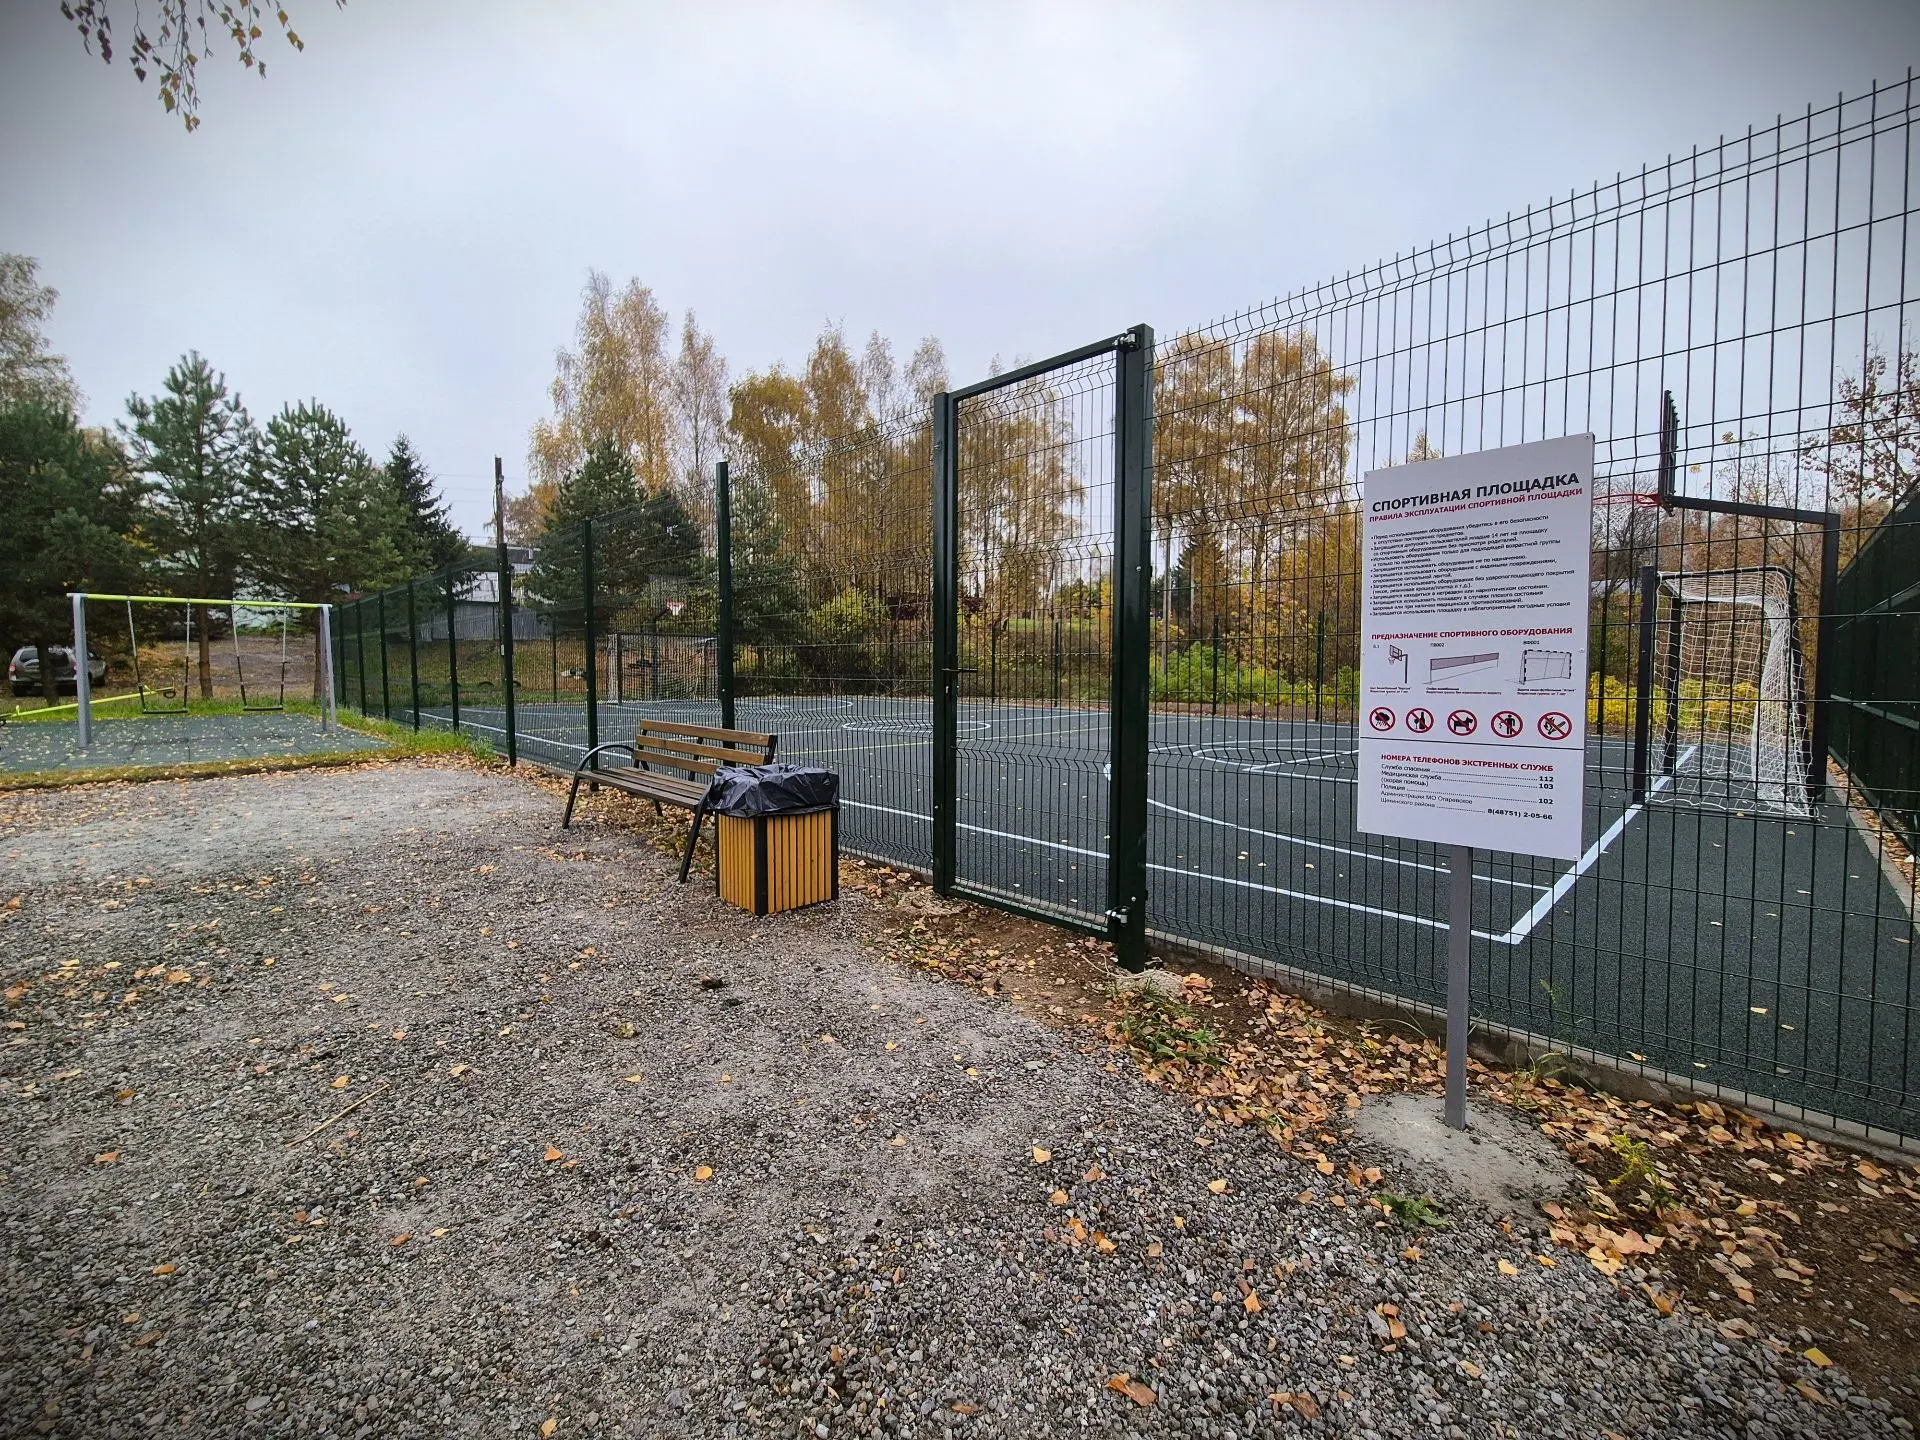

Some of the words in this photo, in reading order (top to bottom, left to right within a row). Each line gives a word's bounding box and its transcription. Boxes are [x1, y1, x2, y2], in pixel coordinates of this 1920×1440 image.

[1372, 488, 1470, 512] СПОРТИВНАЯ
[1476, 472, 1579, 499] ПЛОЩАДКА
[1369, 512, 1402, 522] ПРАВИЛА
[1404, 503, 1465, 517] ЭКСПЛУАТАЦИИ
[1467, 494, 1525, 509] СПОРТИВНОЙ
[1527, 487, 1582, 502] ПЛОЩАДКИ
[1439, 629, 1498, 637] СПОРТИВНОГО
[1500, 627, 1572, 636] ОБОРУДОВАНИЯ
[1412, 756, 1460, 765] ТЕЛЕФОНОВ
[1461, 759, 1518, 769] ЭКСТРЕННЫХ
[1520, 763, 1553, 771] СЛУЖБ
[1487, 808, 1520, 817] 8(48751)
[1523, 811, 1552, 820] 2-05-66
